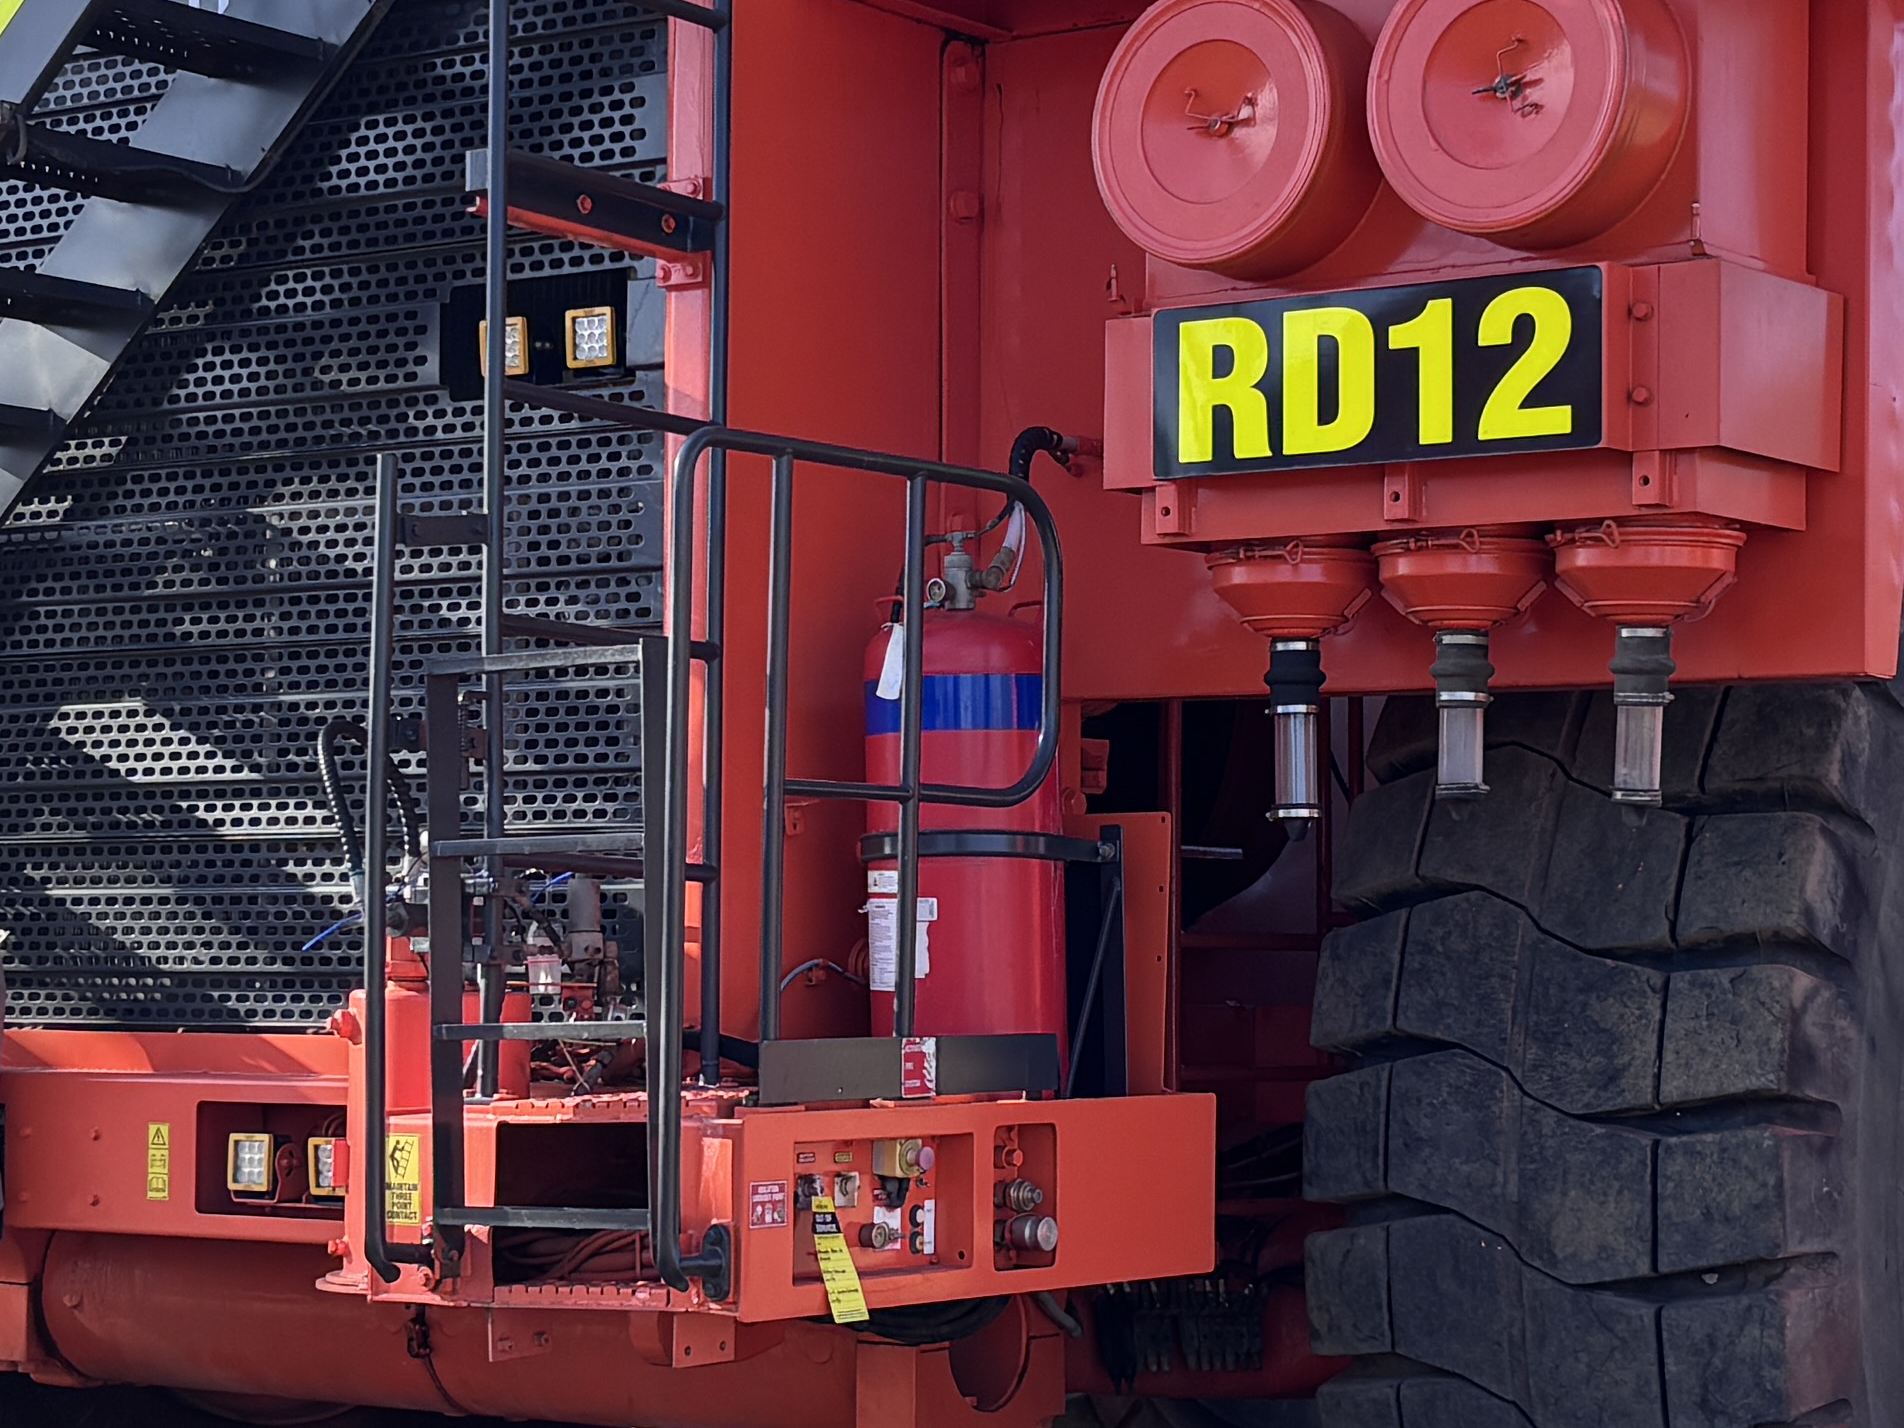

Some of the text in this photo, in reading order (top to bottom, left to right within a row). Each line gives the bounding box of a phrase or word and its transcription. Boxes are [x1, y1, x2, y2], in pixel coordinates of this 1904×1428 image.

[1177, 286, 1573, 464] RD12
[391, 1192, 412, 1200] THREE
[392, 1202, 412, 1210] POINT
[387, 1211, 417, 1220] CONTACT
